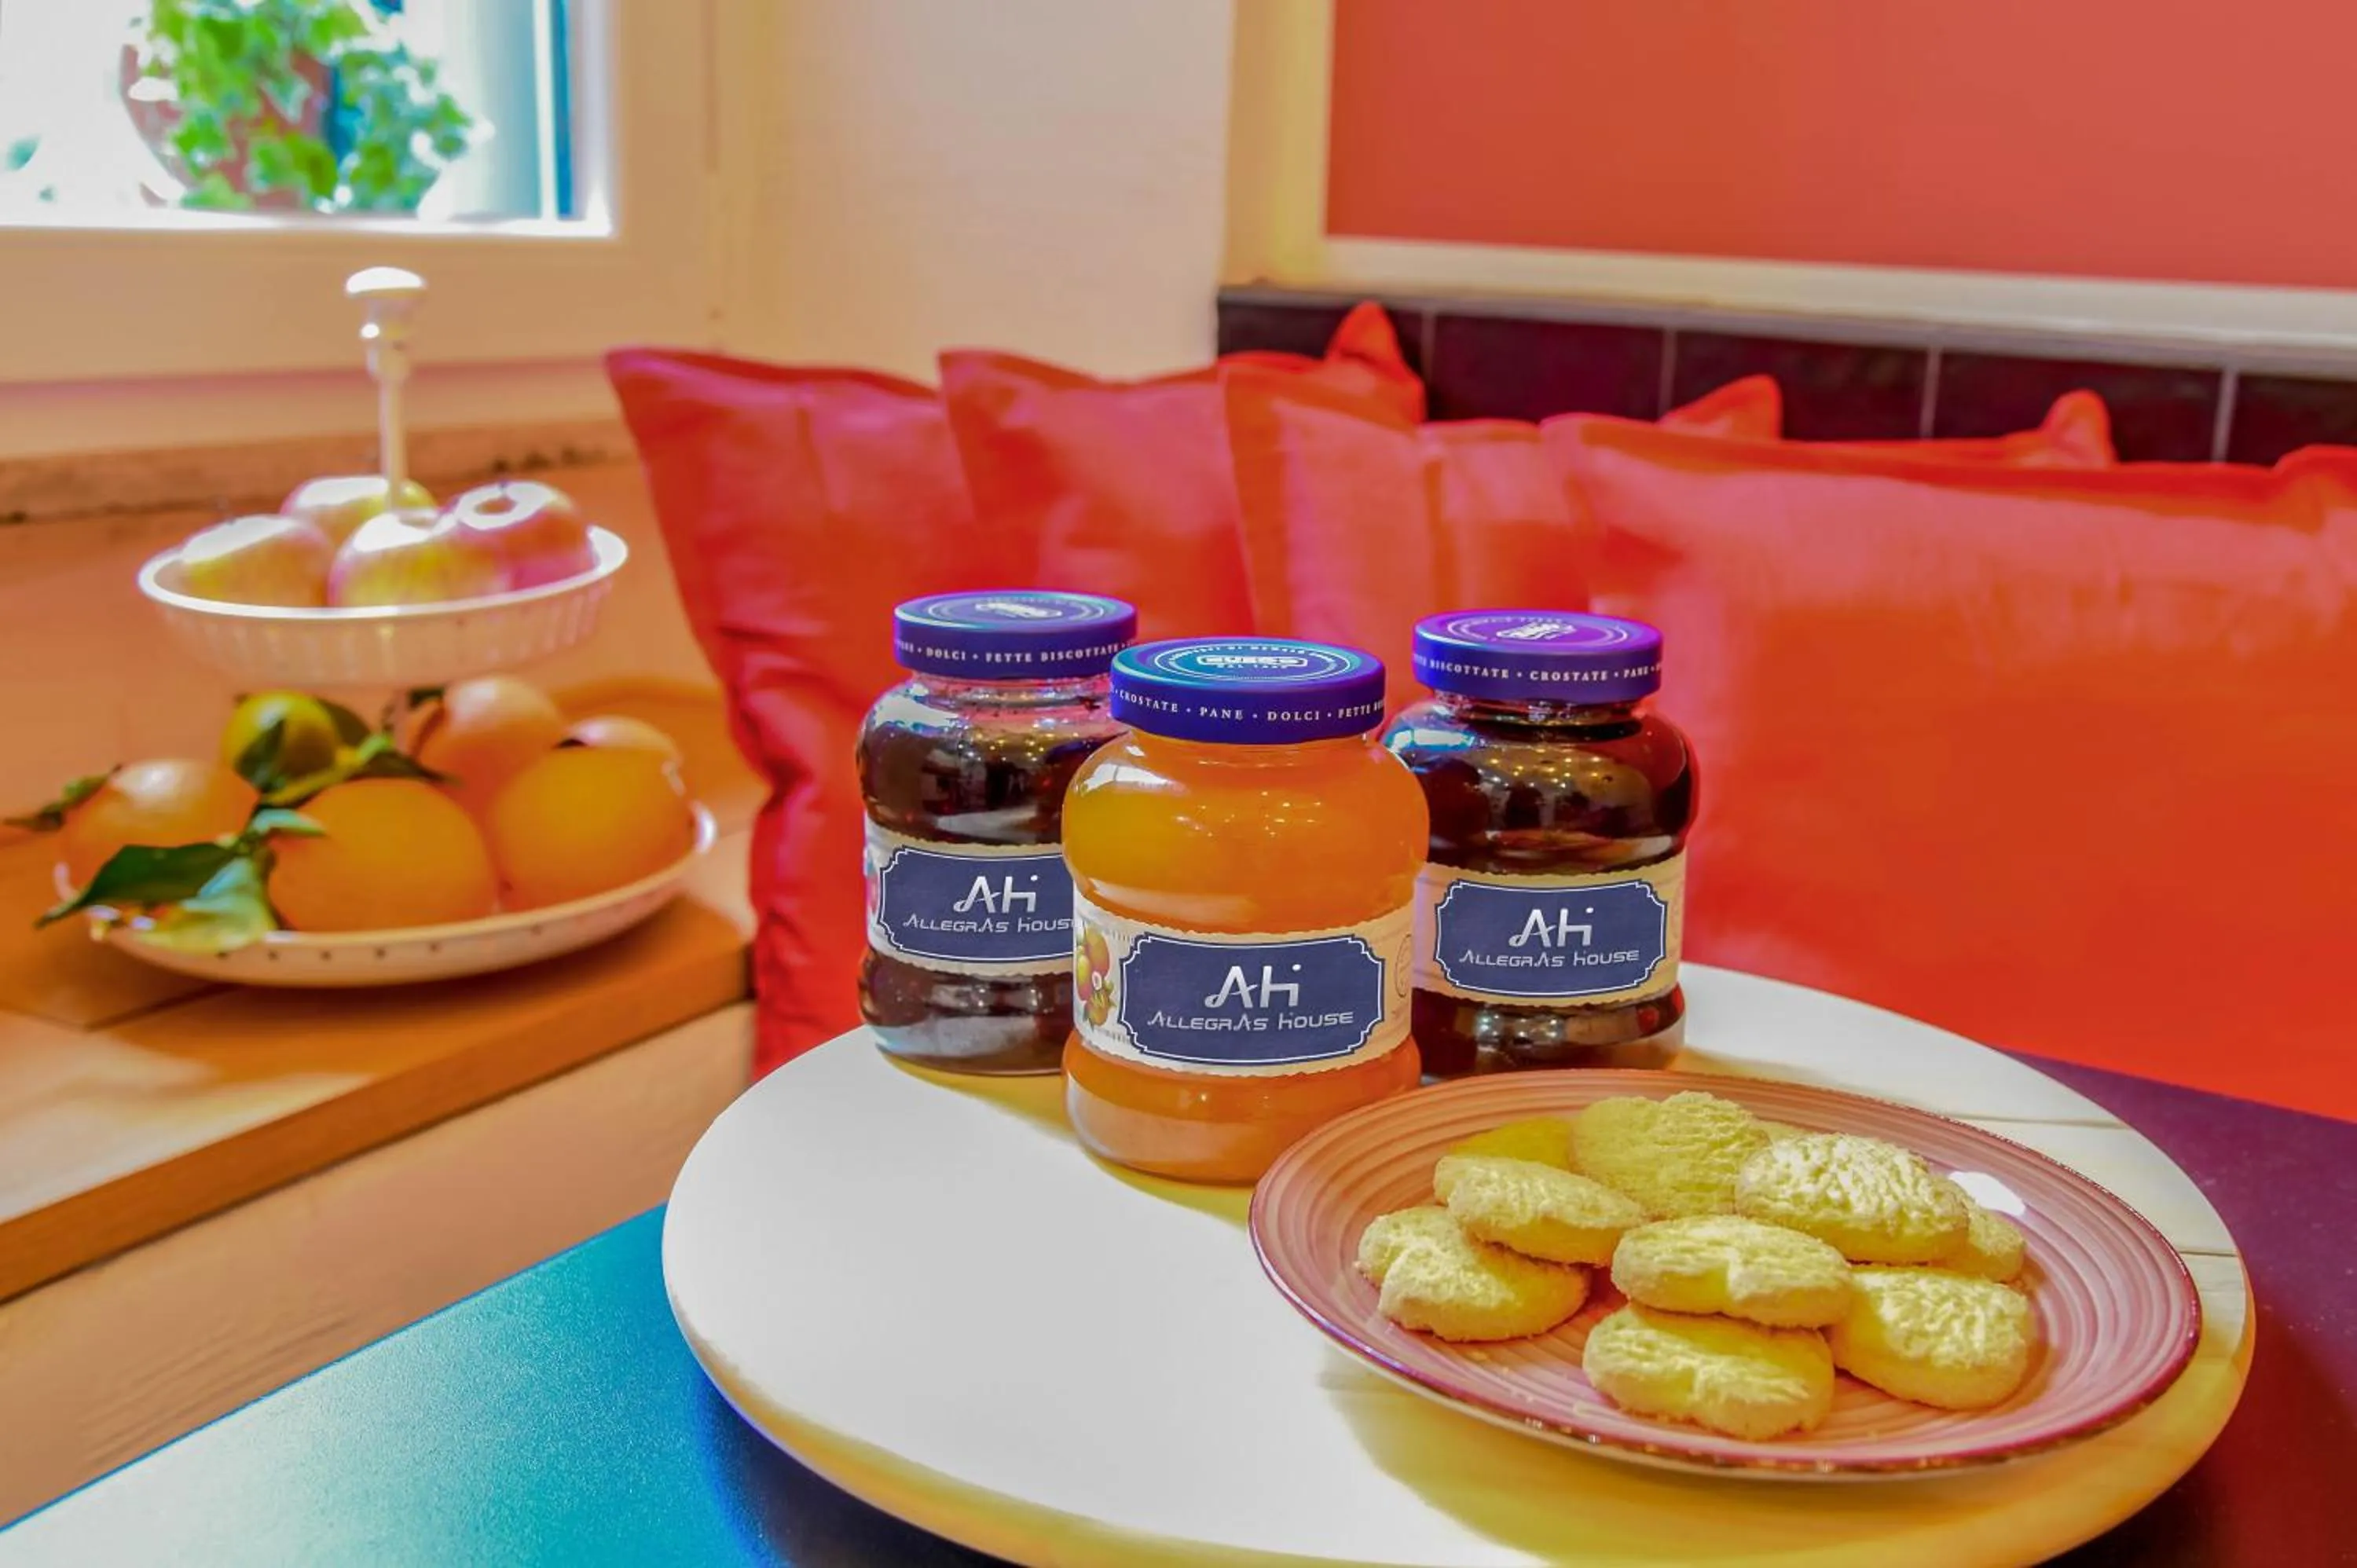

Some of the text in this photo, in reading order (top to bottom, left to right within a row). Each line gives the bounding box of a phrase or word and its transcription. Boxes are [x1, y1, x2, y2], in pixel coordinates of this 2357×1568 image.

[926, 646, 966, 661] DOLCI
[985, 653, 1032, 663] FETTE
[1530, 669, 1608, 682] CROSTATE
[1120, 689, 1178, 713] CROSTATE
[1200, 707, 1244, 720] PANE
[1266, 711, 1321, 721] DOLCI
